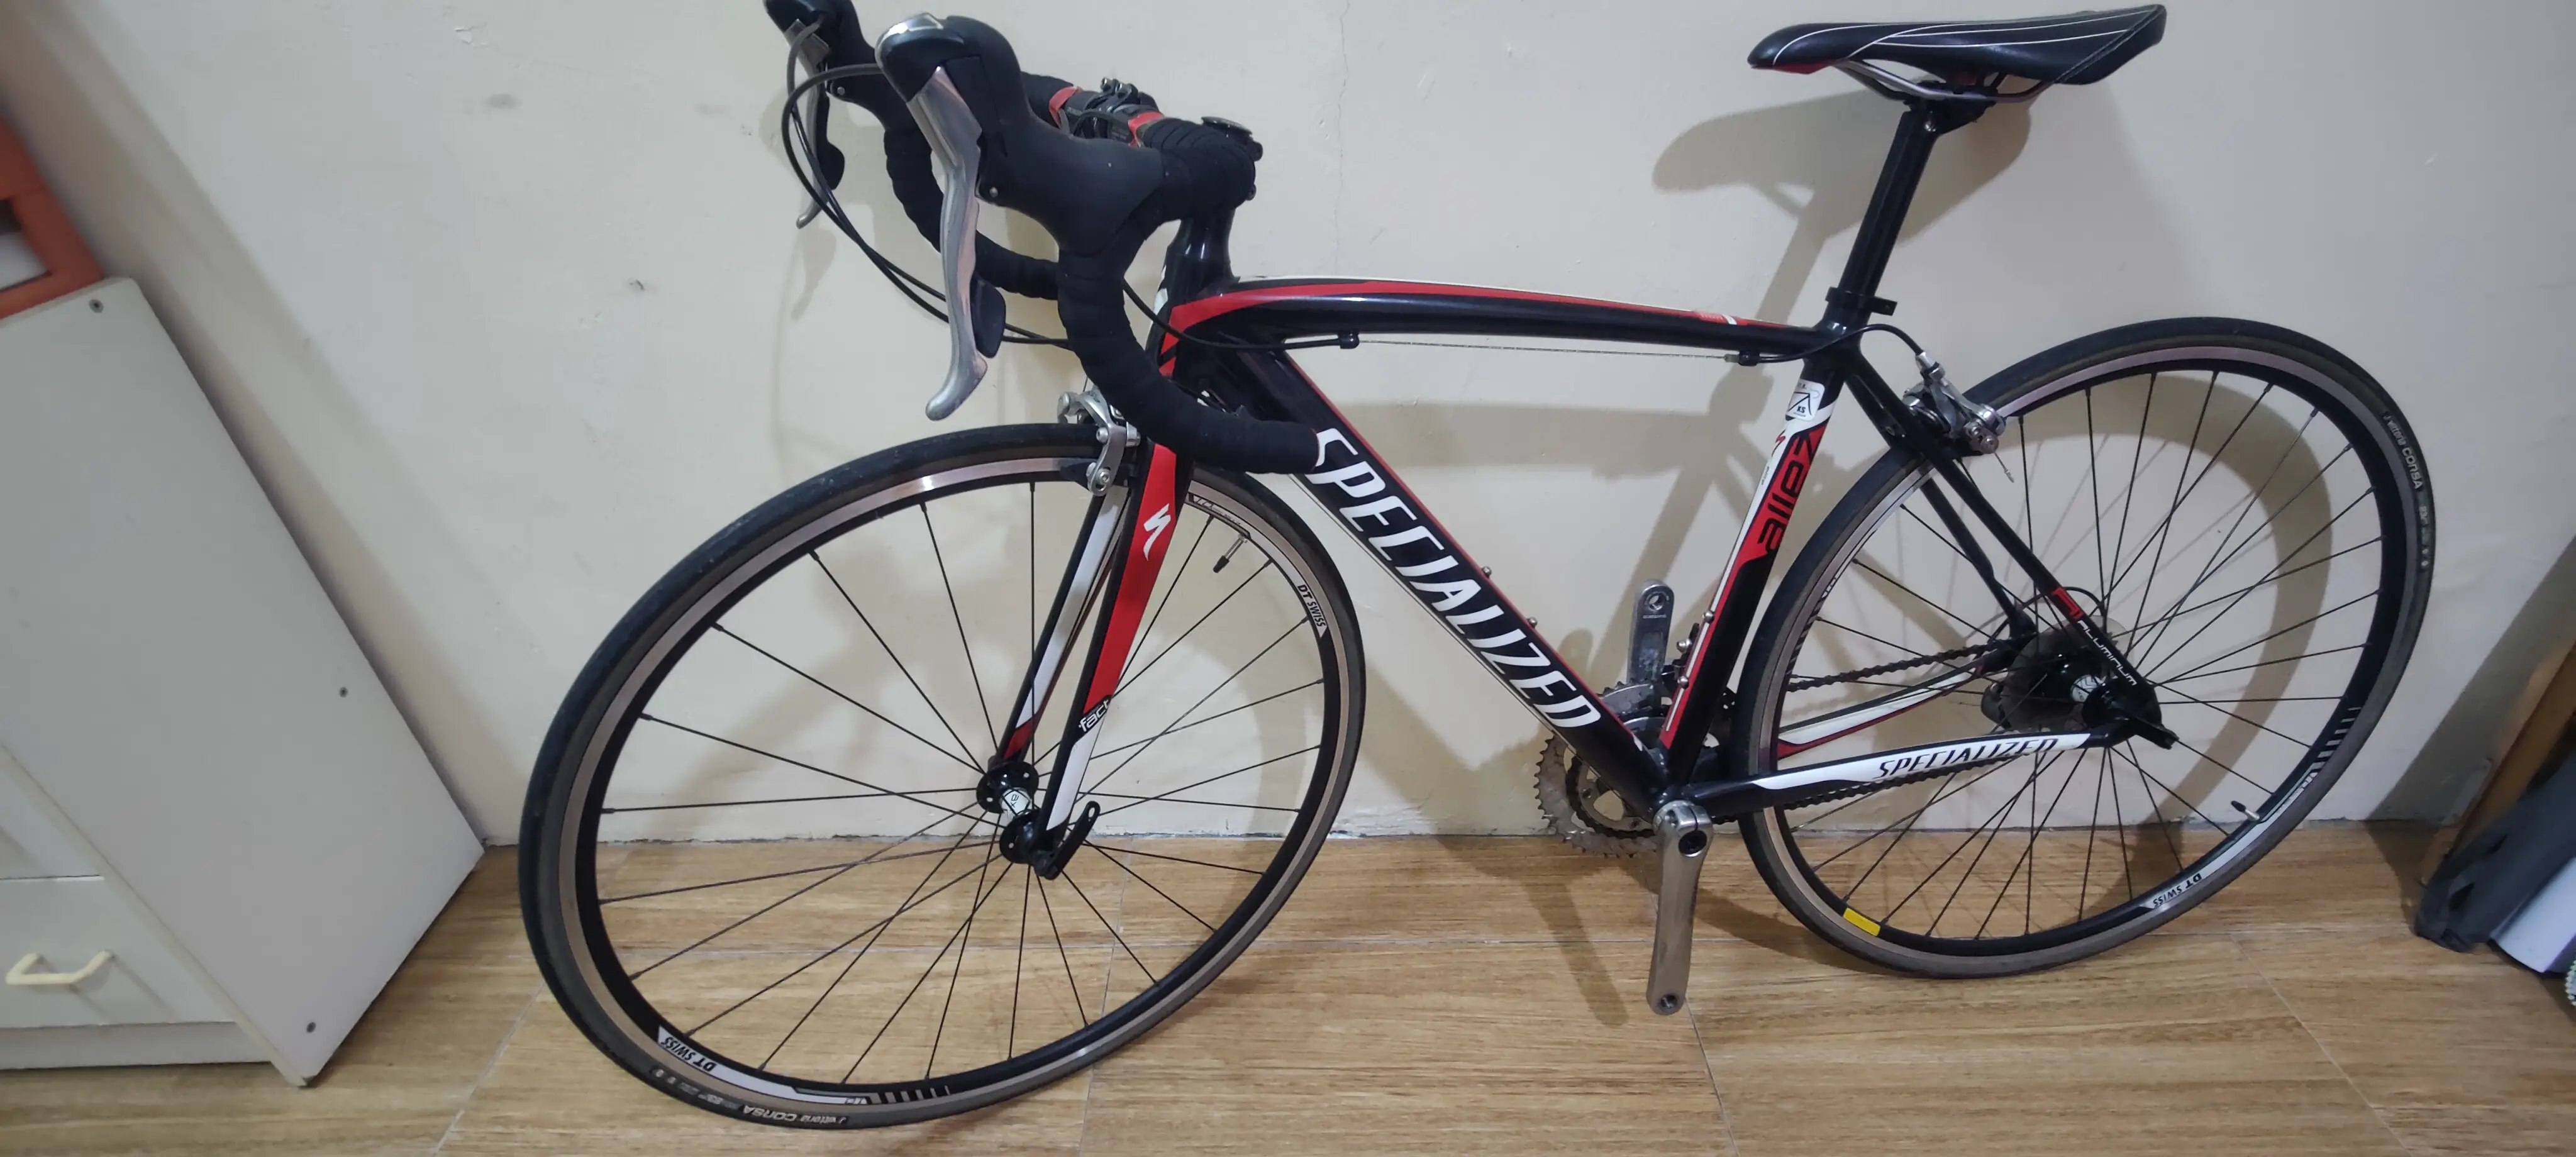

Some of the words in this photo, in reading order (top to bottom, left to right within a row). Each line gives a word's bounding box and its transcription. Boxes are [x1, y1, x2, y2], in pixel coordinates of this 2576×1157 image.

[2402, 447, 2423, 489] CORSA
[1305, 428, 1601, 728] SPECIALIZED
[1297, 584, 1313, 601] DT
[1307, 601, 1326, 627] SWISS
[1872, 738, 2059, 779] SPECIALIZED
[2185, 873, 2202, 888] DT
[2152, 885, 2182, 907] SWISS
[660, 1036, 696, 1061] SWISS
[692, 1057, 716, 1072] DT
[742, 1105, 797, 1122] CORSA
